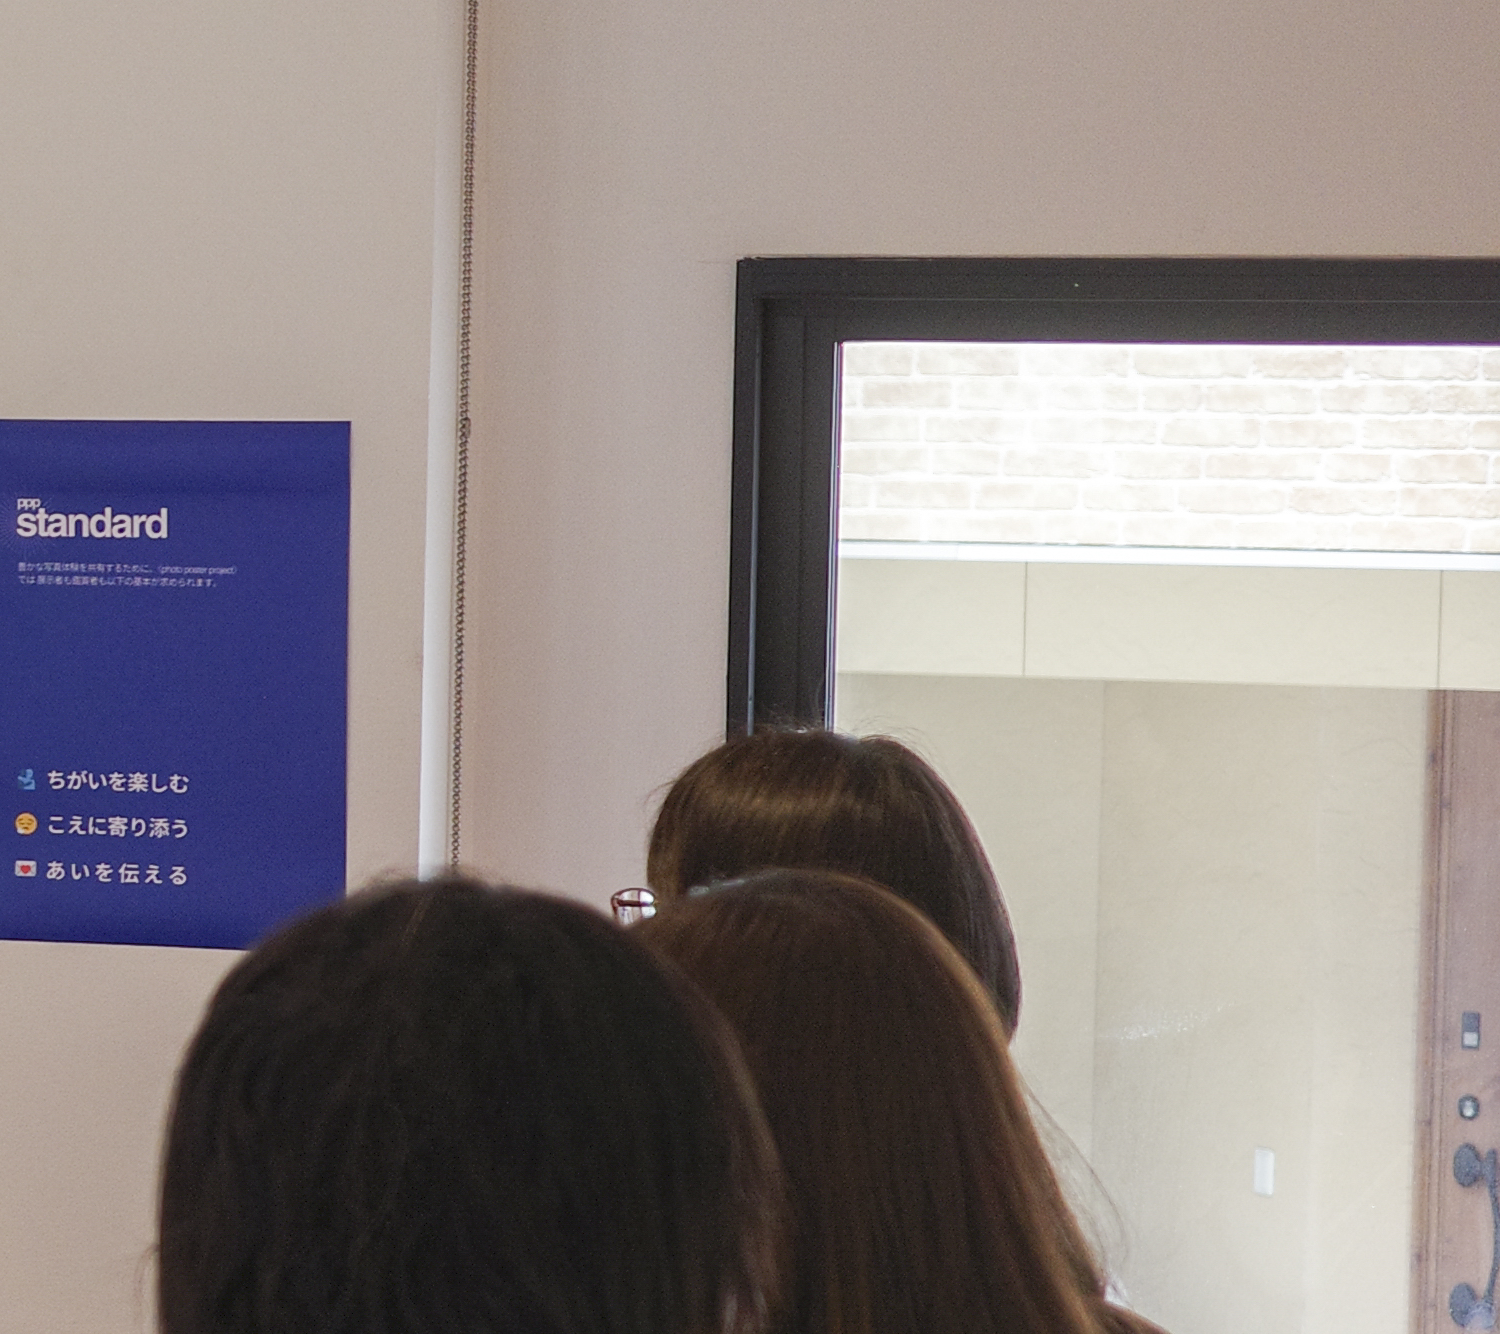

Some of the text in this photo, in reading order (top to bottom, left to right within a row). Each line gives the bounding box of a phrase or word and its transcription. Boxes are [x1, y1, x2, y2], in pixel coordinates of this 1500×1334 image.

[17, 498, 41, 510] ppp
[16, 506, 168, 539] standard
[47, 770, 189, 794] ちがいを楽しむ
[48, 815, 188, 839] こえに寄り添う
[46, 860, 187, 886] あいを伝える
